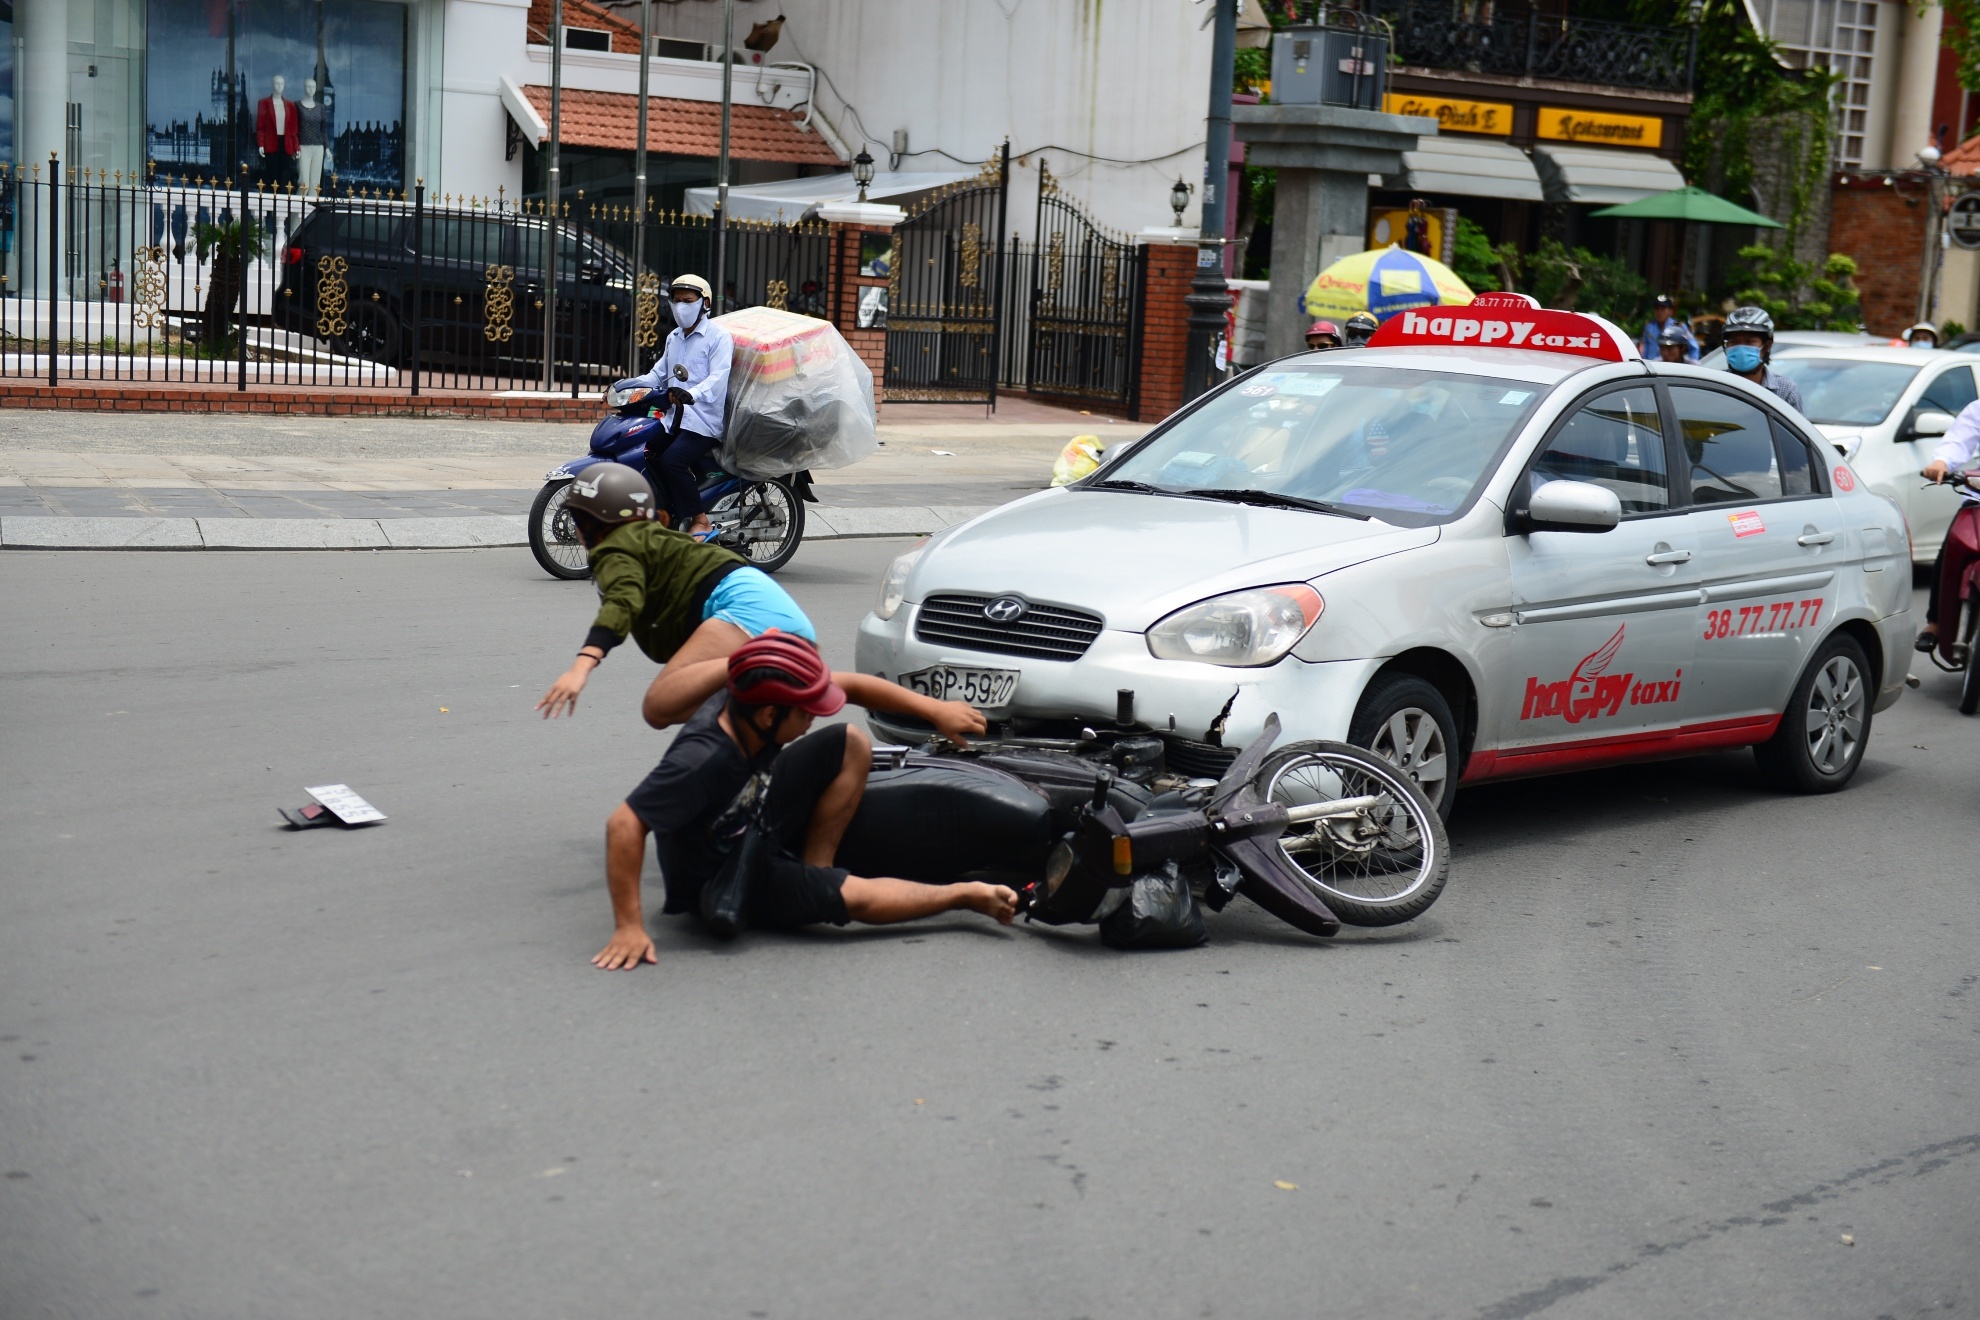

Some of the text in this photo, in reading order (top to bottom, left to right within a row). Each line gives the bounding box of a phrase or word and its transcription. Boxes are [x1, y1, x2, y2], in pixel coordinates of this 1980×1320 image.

[1503, 299, 1514, 308] 77
[1516, 299, 1528, 309] 77
[1402, 312, 1601, 349] happy taxi
[1241, 385, 1275, 397] 561
[1836, 471, 1853, 489] 561
[1703, 598, 1824, 641] 38.77.77.77
[1630, 668, 1682, 706] taxi
